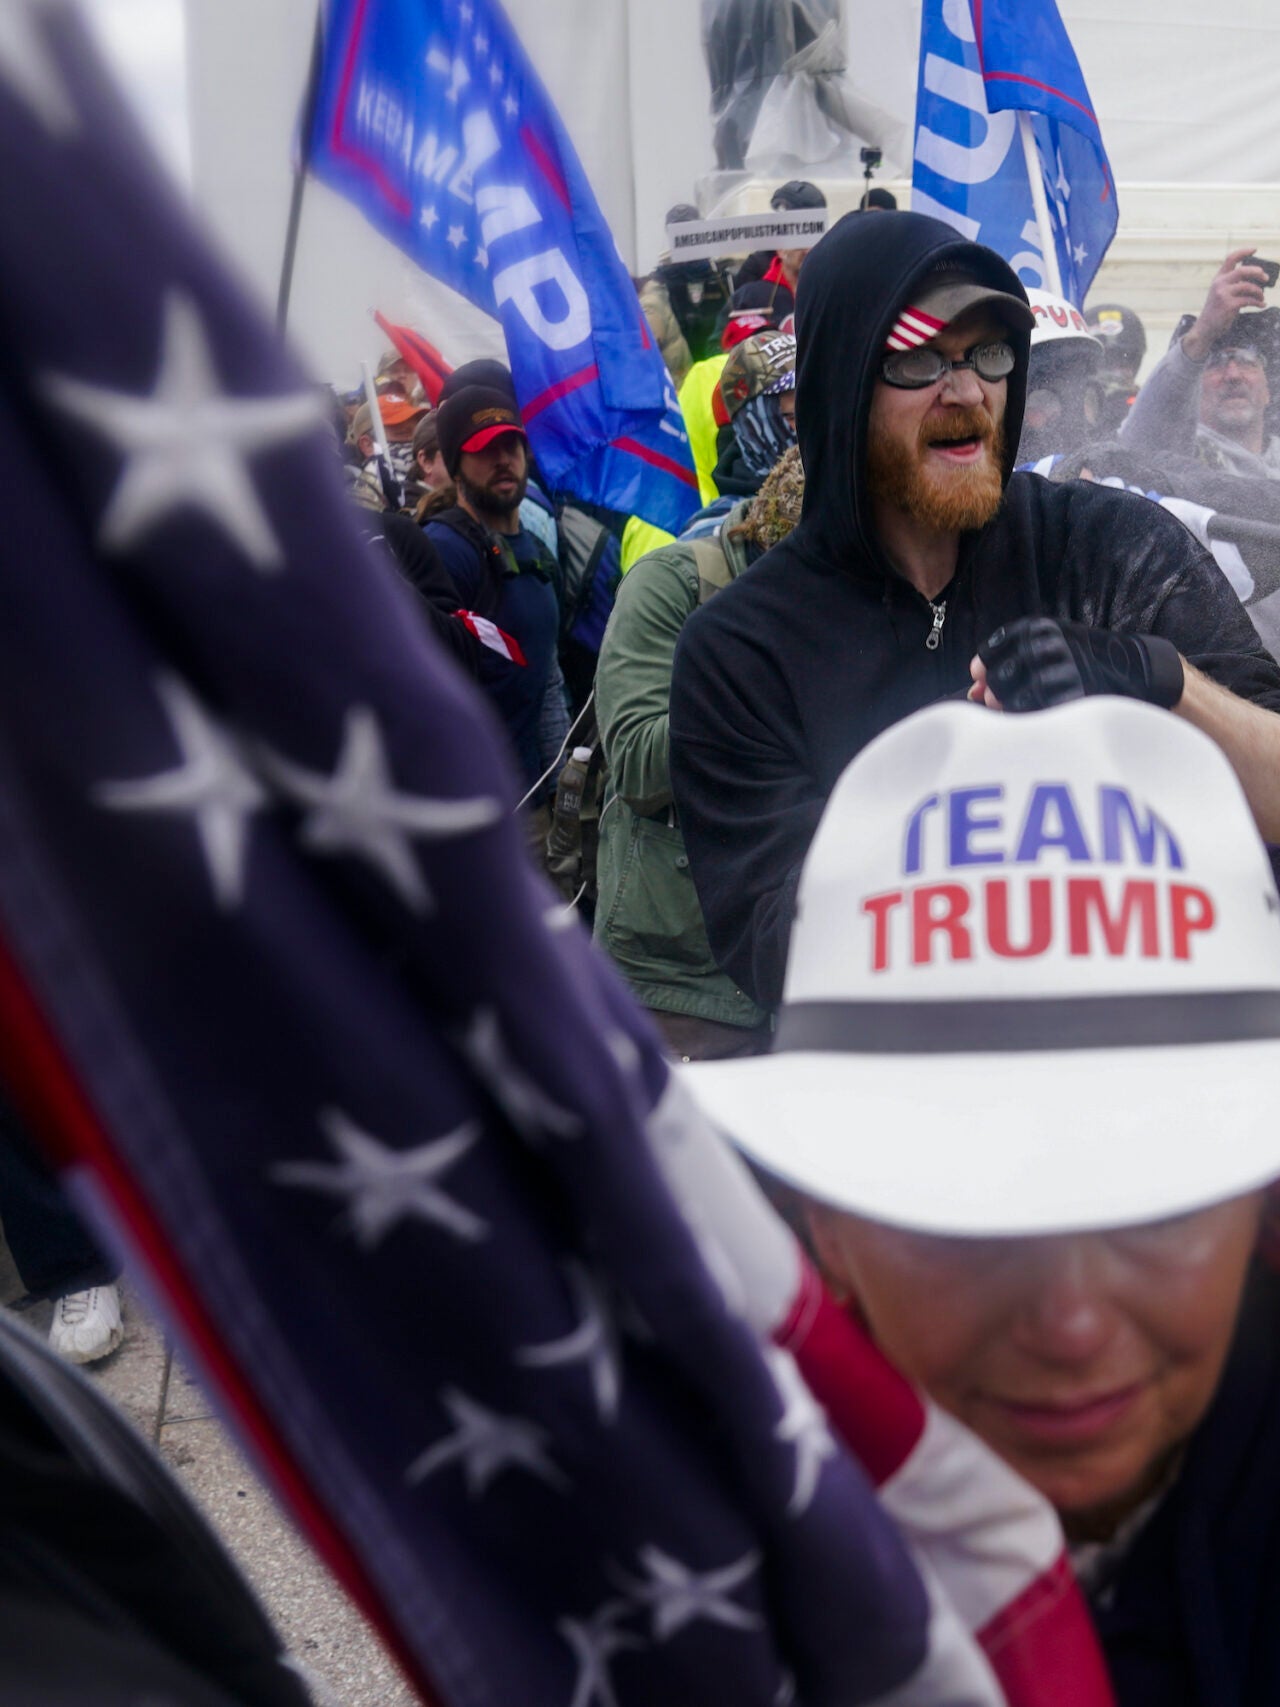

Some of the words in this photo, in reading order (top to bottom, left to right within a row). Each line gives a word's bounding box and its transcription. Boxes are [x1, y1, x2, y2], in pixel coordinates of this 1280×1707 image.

[674, 221, 825, 248] AMERICANPOPULISTPARTY.COM
[759, 334, 798, 357] TRU
[904, 782, 1186, 874] TEAM
[862, 876, 1217, 972] TRUMP
